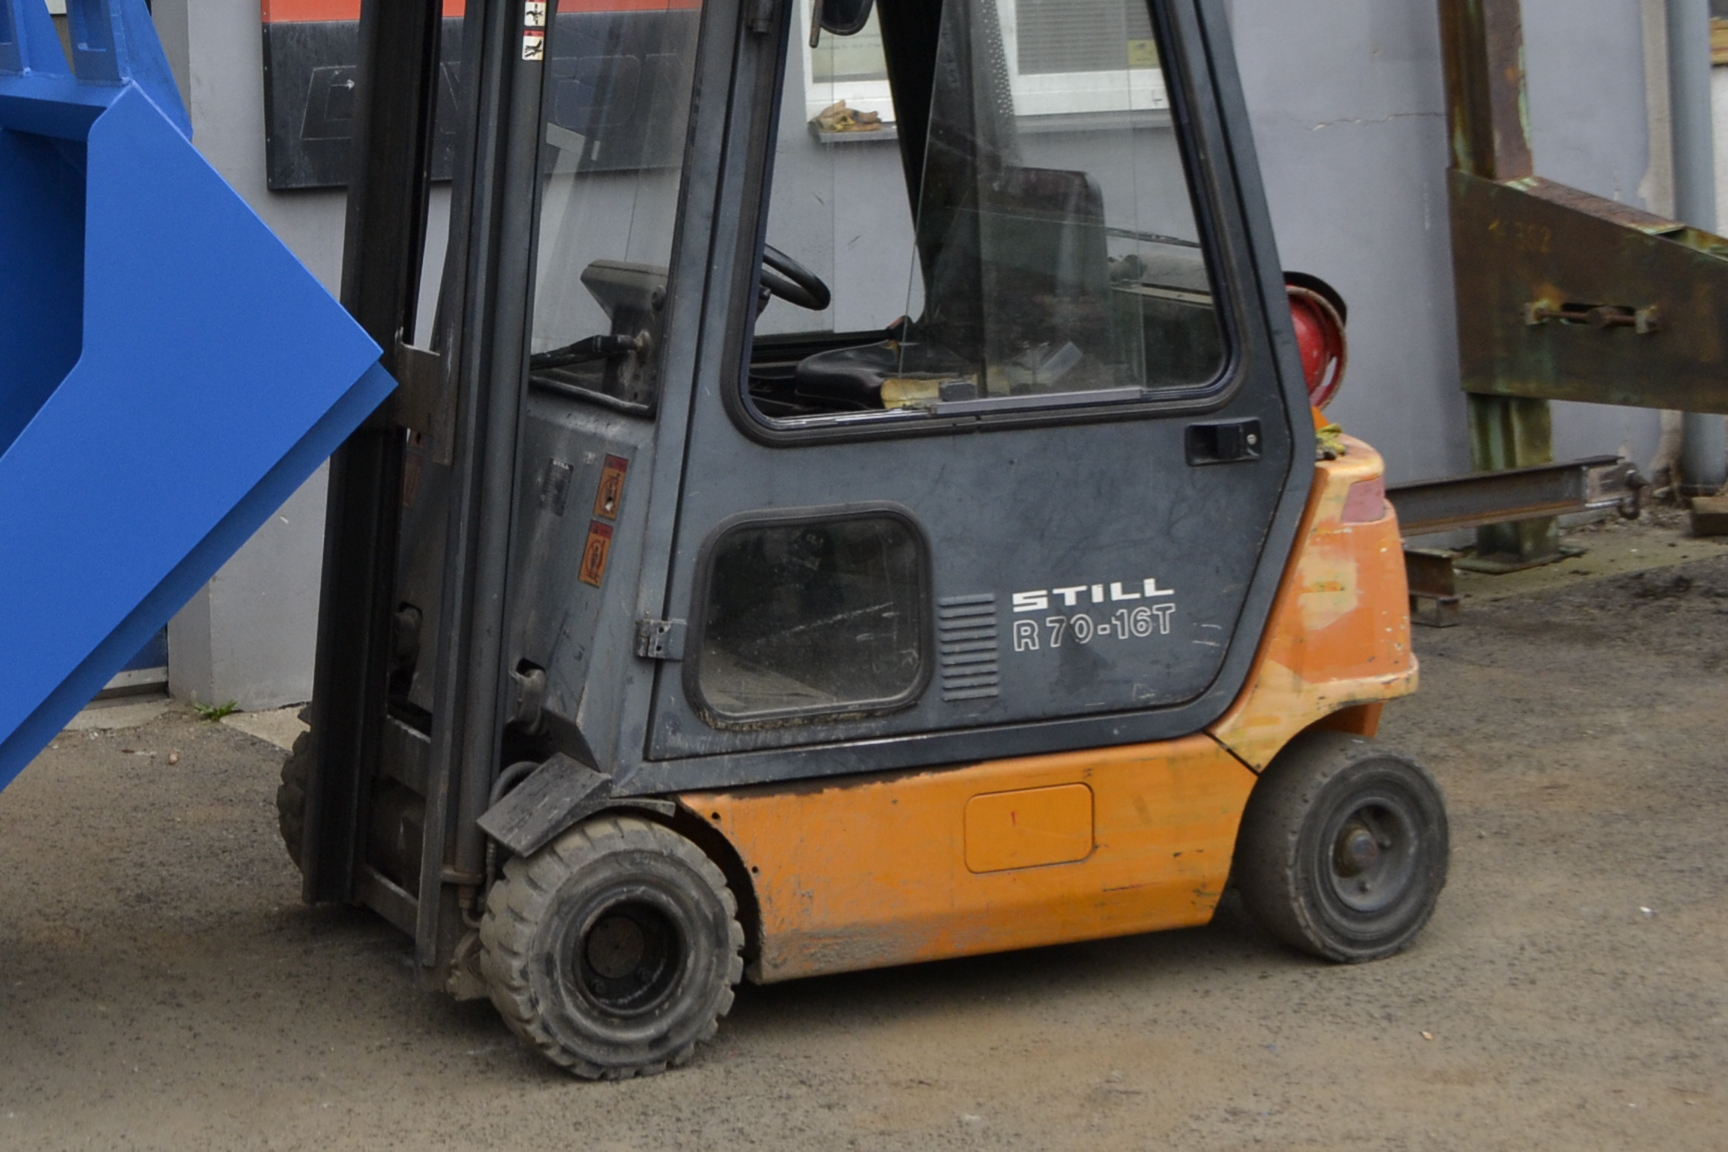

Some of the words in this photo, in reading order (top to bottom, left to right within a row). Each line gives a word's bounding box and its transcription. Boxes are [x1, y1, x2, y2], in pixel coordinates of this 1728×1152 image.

[1012, 577, 1175, 613] STILL
[1013, 619, 1040, 652] R
[1046, 602, 1176, 649] 70-16T
